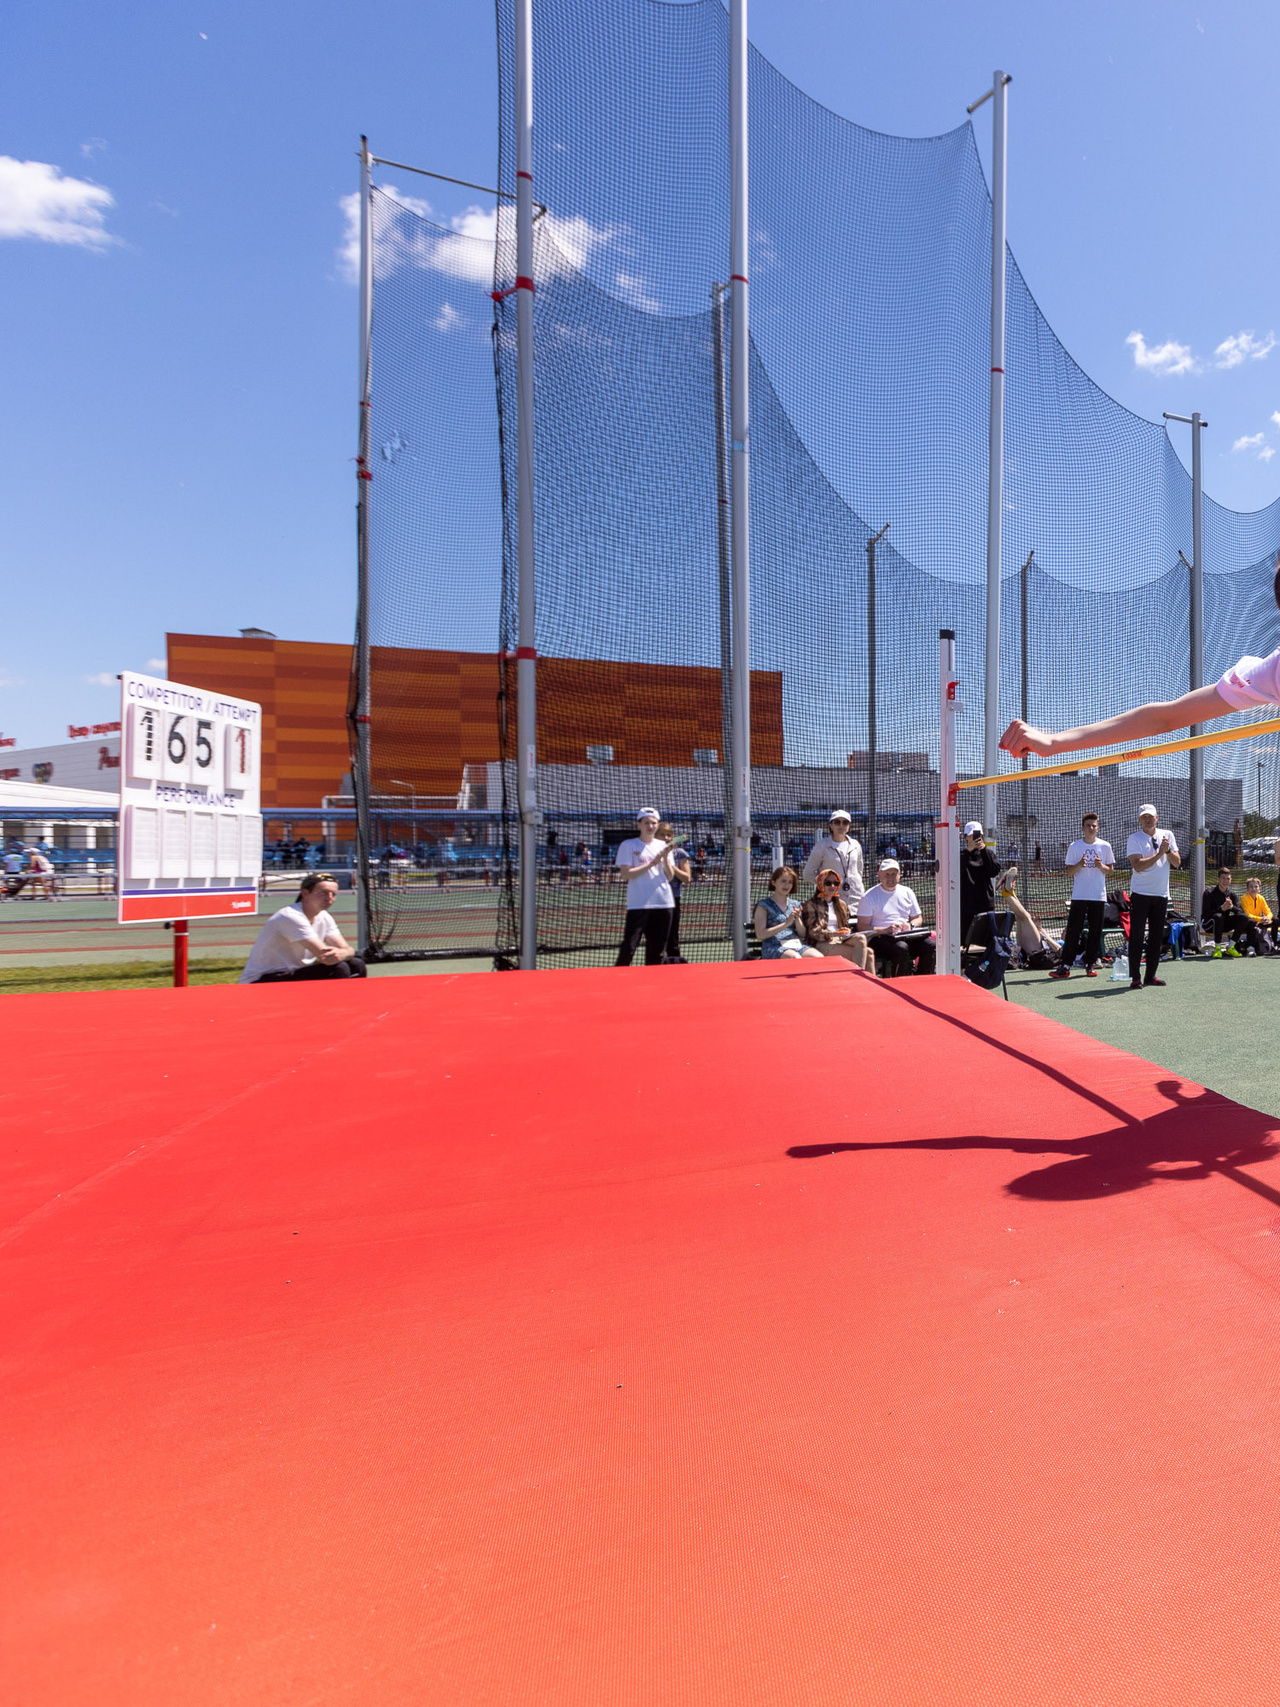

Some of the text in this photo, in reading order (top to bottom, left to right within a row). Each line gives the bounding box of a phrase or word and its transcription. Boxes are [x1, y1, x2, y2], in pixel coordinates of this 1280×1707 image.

[127, 681, 203, 712] COMPETITOR
[213, 702, 258, 723] ATTEMPT
[235, 729, 246, 774] 1
[156, 786, 236, 808] PERFORMANCE
